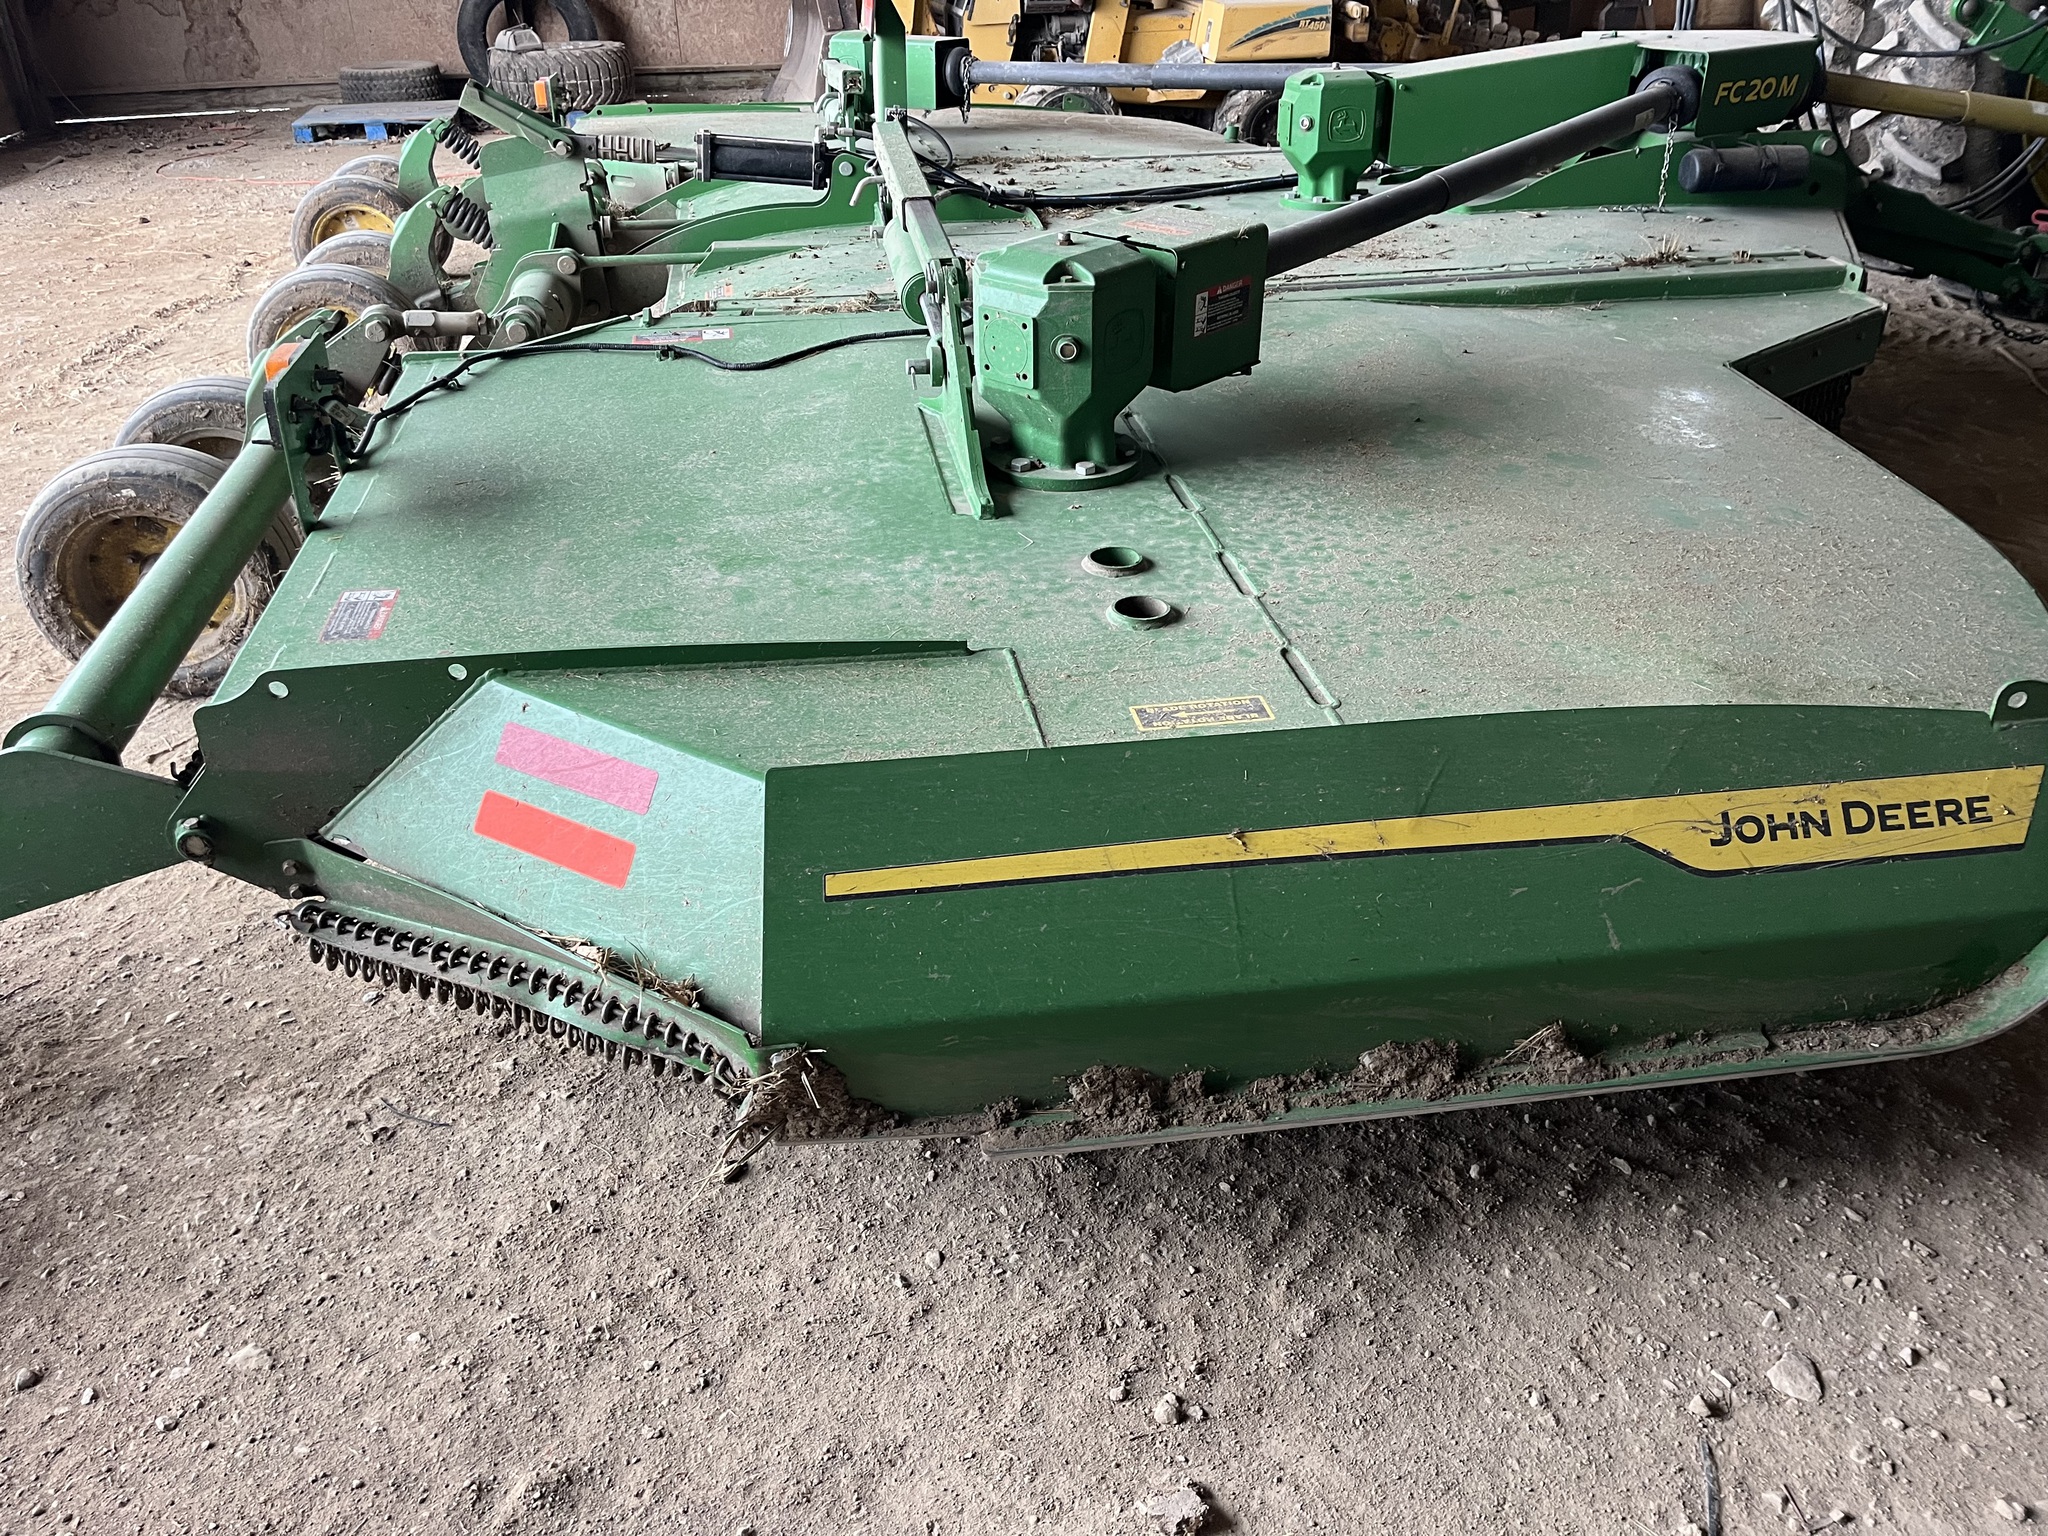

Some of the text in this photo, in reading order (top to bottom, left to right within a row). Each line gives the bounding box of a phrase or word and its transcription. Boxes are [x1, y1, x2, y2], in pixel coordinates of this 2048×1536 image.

[1298, 19, 1326, 31] RT450
[1223, 280, 1242, 292] DANGER
[1190, 699, 1251, 711] ROTATION
[1709, 795, 1993, 847] JOHN DEERE
